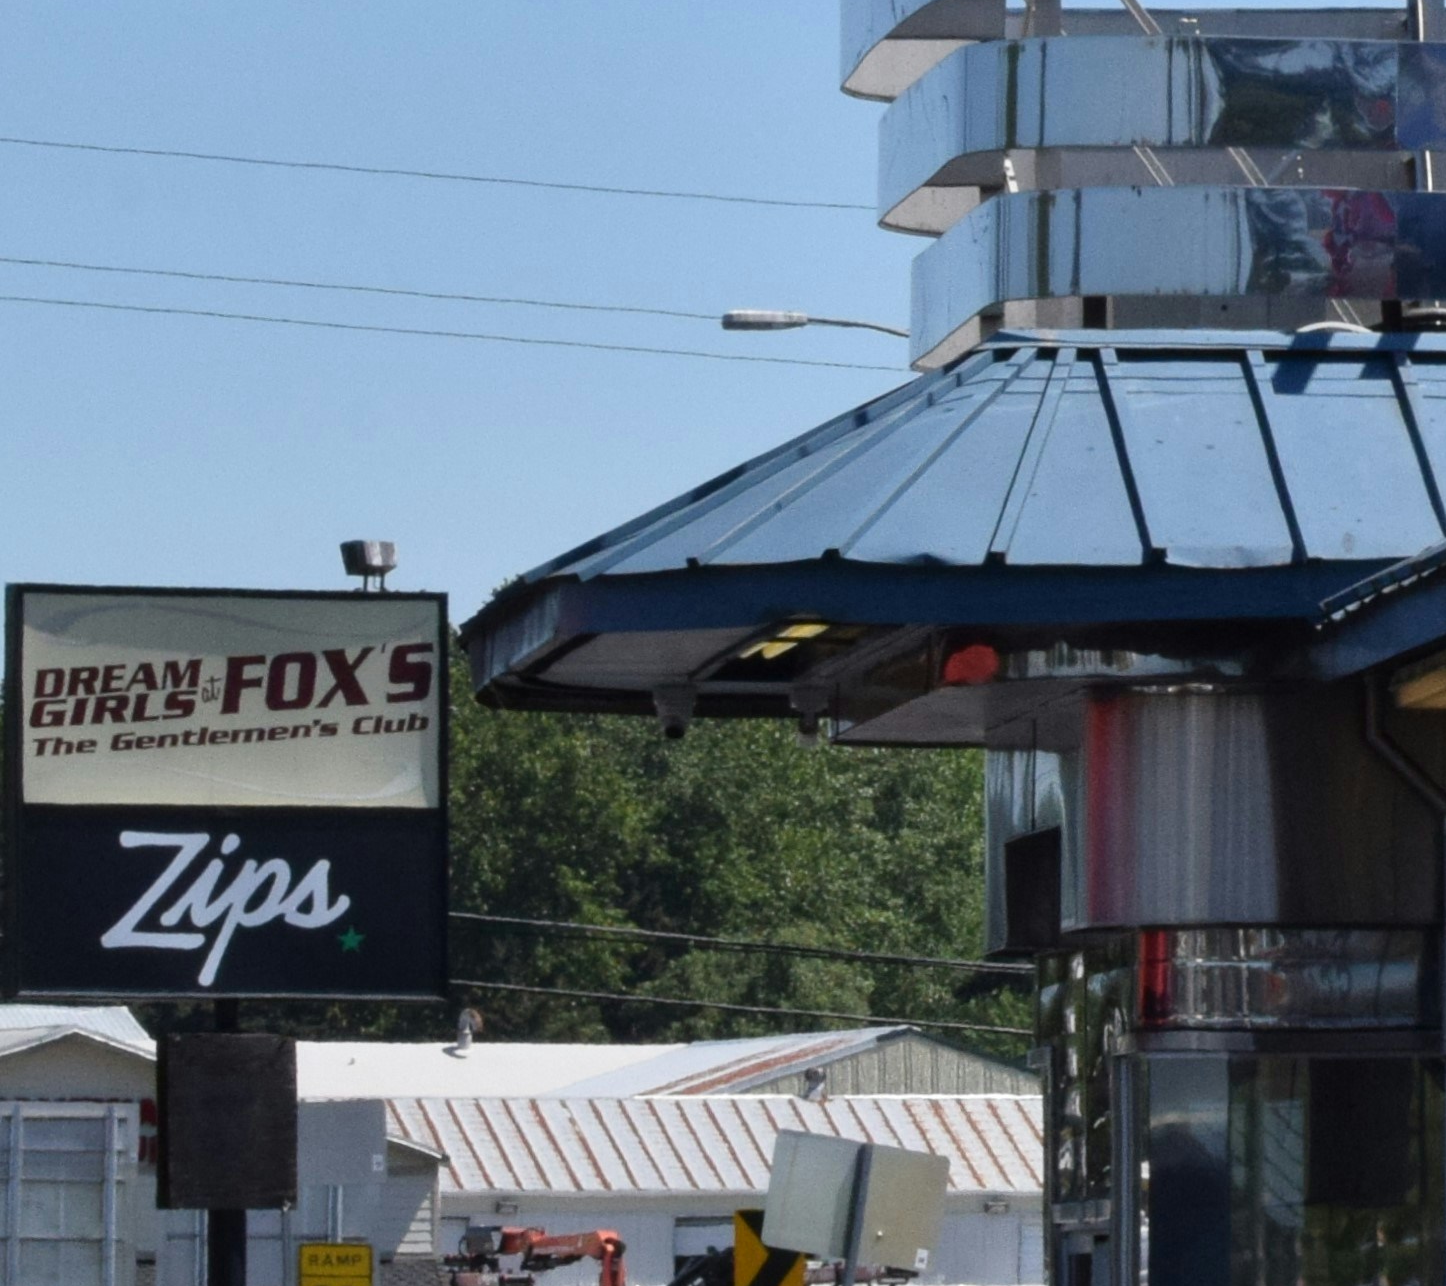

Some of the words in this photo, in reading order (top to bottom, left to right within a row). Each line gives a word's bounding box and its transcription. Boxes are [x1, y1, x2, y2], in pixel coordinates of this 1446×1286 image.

[34, 659, 202, 698] DREAM
[201, 675, 222, 703] at
[220, 642, 434, 715] FOX'S
[29, 690, 196, 729] GIRLS
[33, 737, 97, 757] The
[110, 718, 339, 752] Gentlemen's
[351, 713, 430, 735] Club
[101, 830, 351, 987] Zips
[308, 1254, 362, 1267] RAMP
